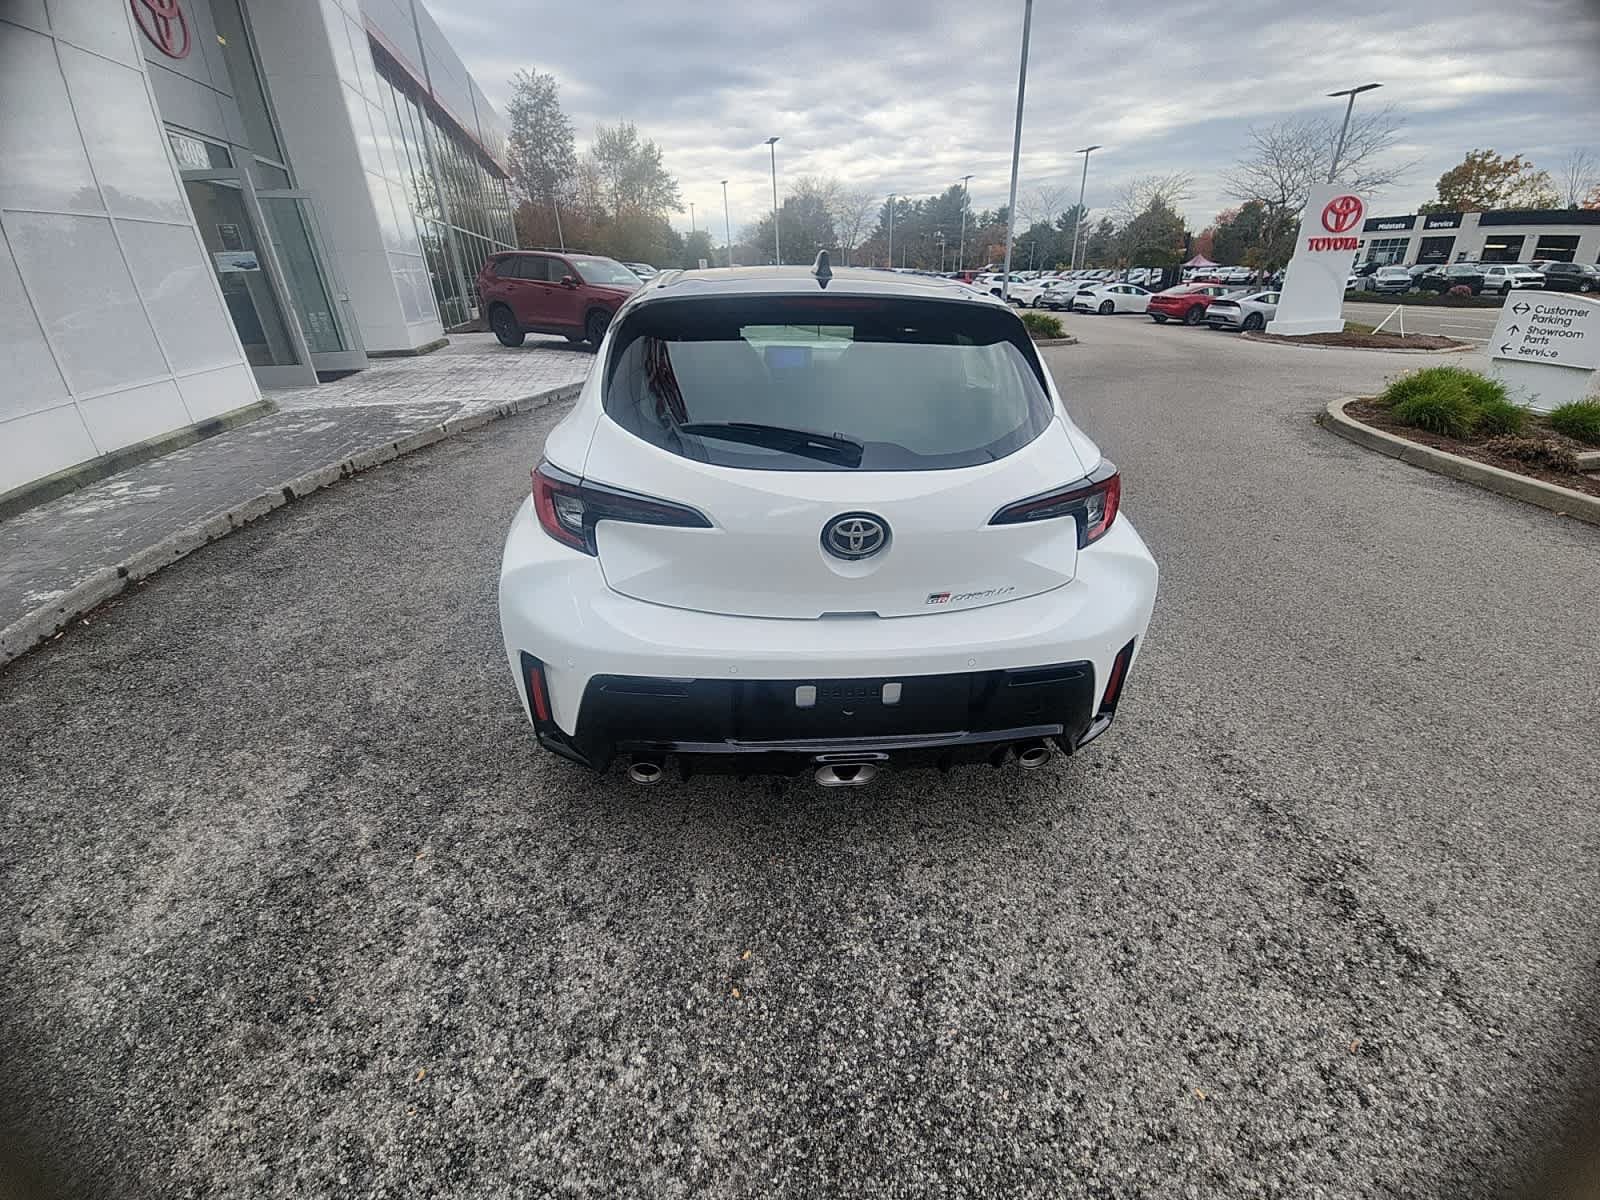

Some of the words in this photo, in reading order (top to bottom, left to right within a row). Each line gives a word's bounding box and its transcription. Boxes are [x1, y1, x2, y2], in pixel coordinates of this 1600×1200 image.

[1429, 220, 1454, 228] Service
[1308, 237, 1358, 251] TOYOTA
[1535, 304, 1590, 317] Customer
[1531, 314, 1572, 327] Parking
[1526, 325, 1584, 339] Showroom
[1523, 335, 1550, 345] Parts
[1518, 346, 1559, 358] Service
